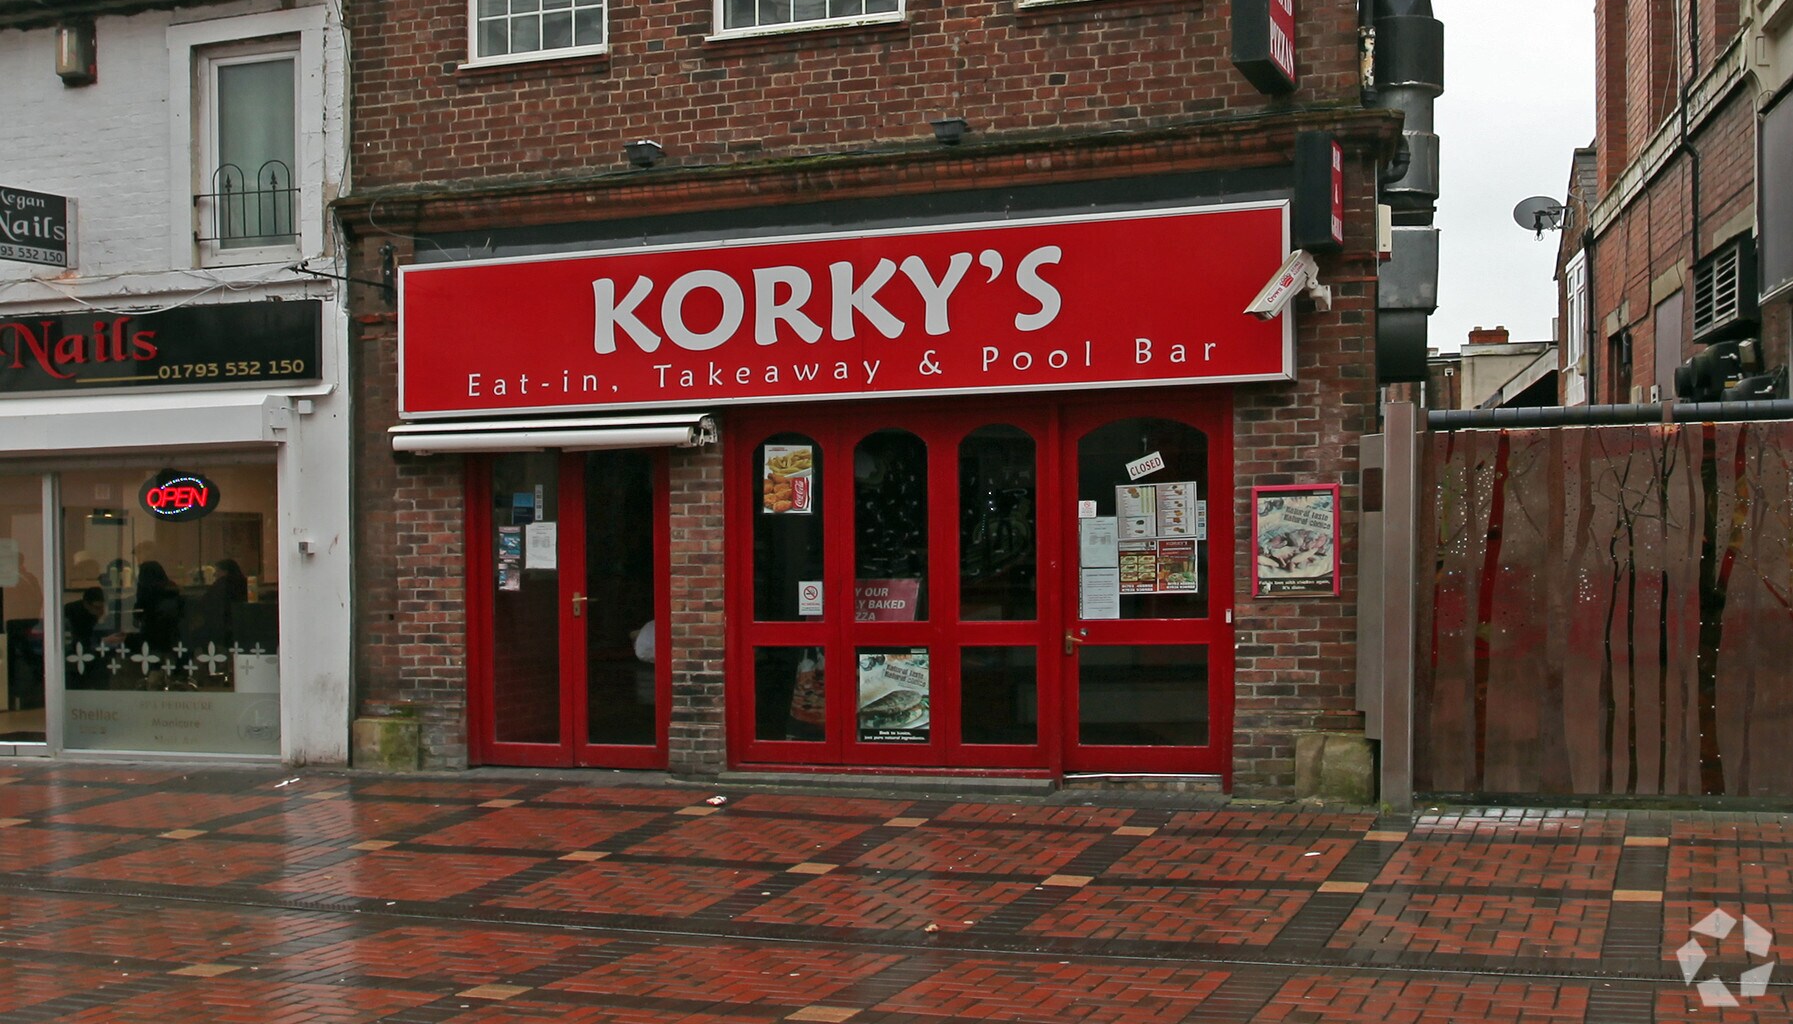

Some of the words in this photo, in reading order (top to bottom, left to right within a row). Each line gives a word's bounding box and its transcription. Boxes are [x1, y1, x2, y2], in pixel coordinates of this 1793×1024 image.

[18, 247, 39, 260] 532
[43, 250, 63, 263] 150
[592, 245, 1062, 354] KORKY'S
[0, 317, 158, 380] Nails
[159, 363, 219, 379] 01793
[225, 360, 261, 376] 532
[269, 359, 305, 374] 150
[467, 369, 619, 397] Eat-in,
[653, 358, 880, 389] Takeaway
[918, 349, 942, 375] &
[982, 340, 1091, 372] Pool
[1135, 337, 1217, 364] Bar
[1130, 457, 1161, 476] CLOSED
[145, 487, 208, 507] OPEN
[864, 587, 889, 597] OUR
[868, 599, 906, 609] BAKED
[71, 708, 118, 722] Shellac
